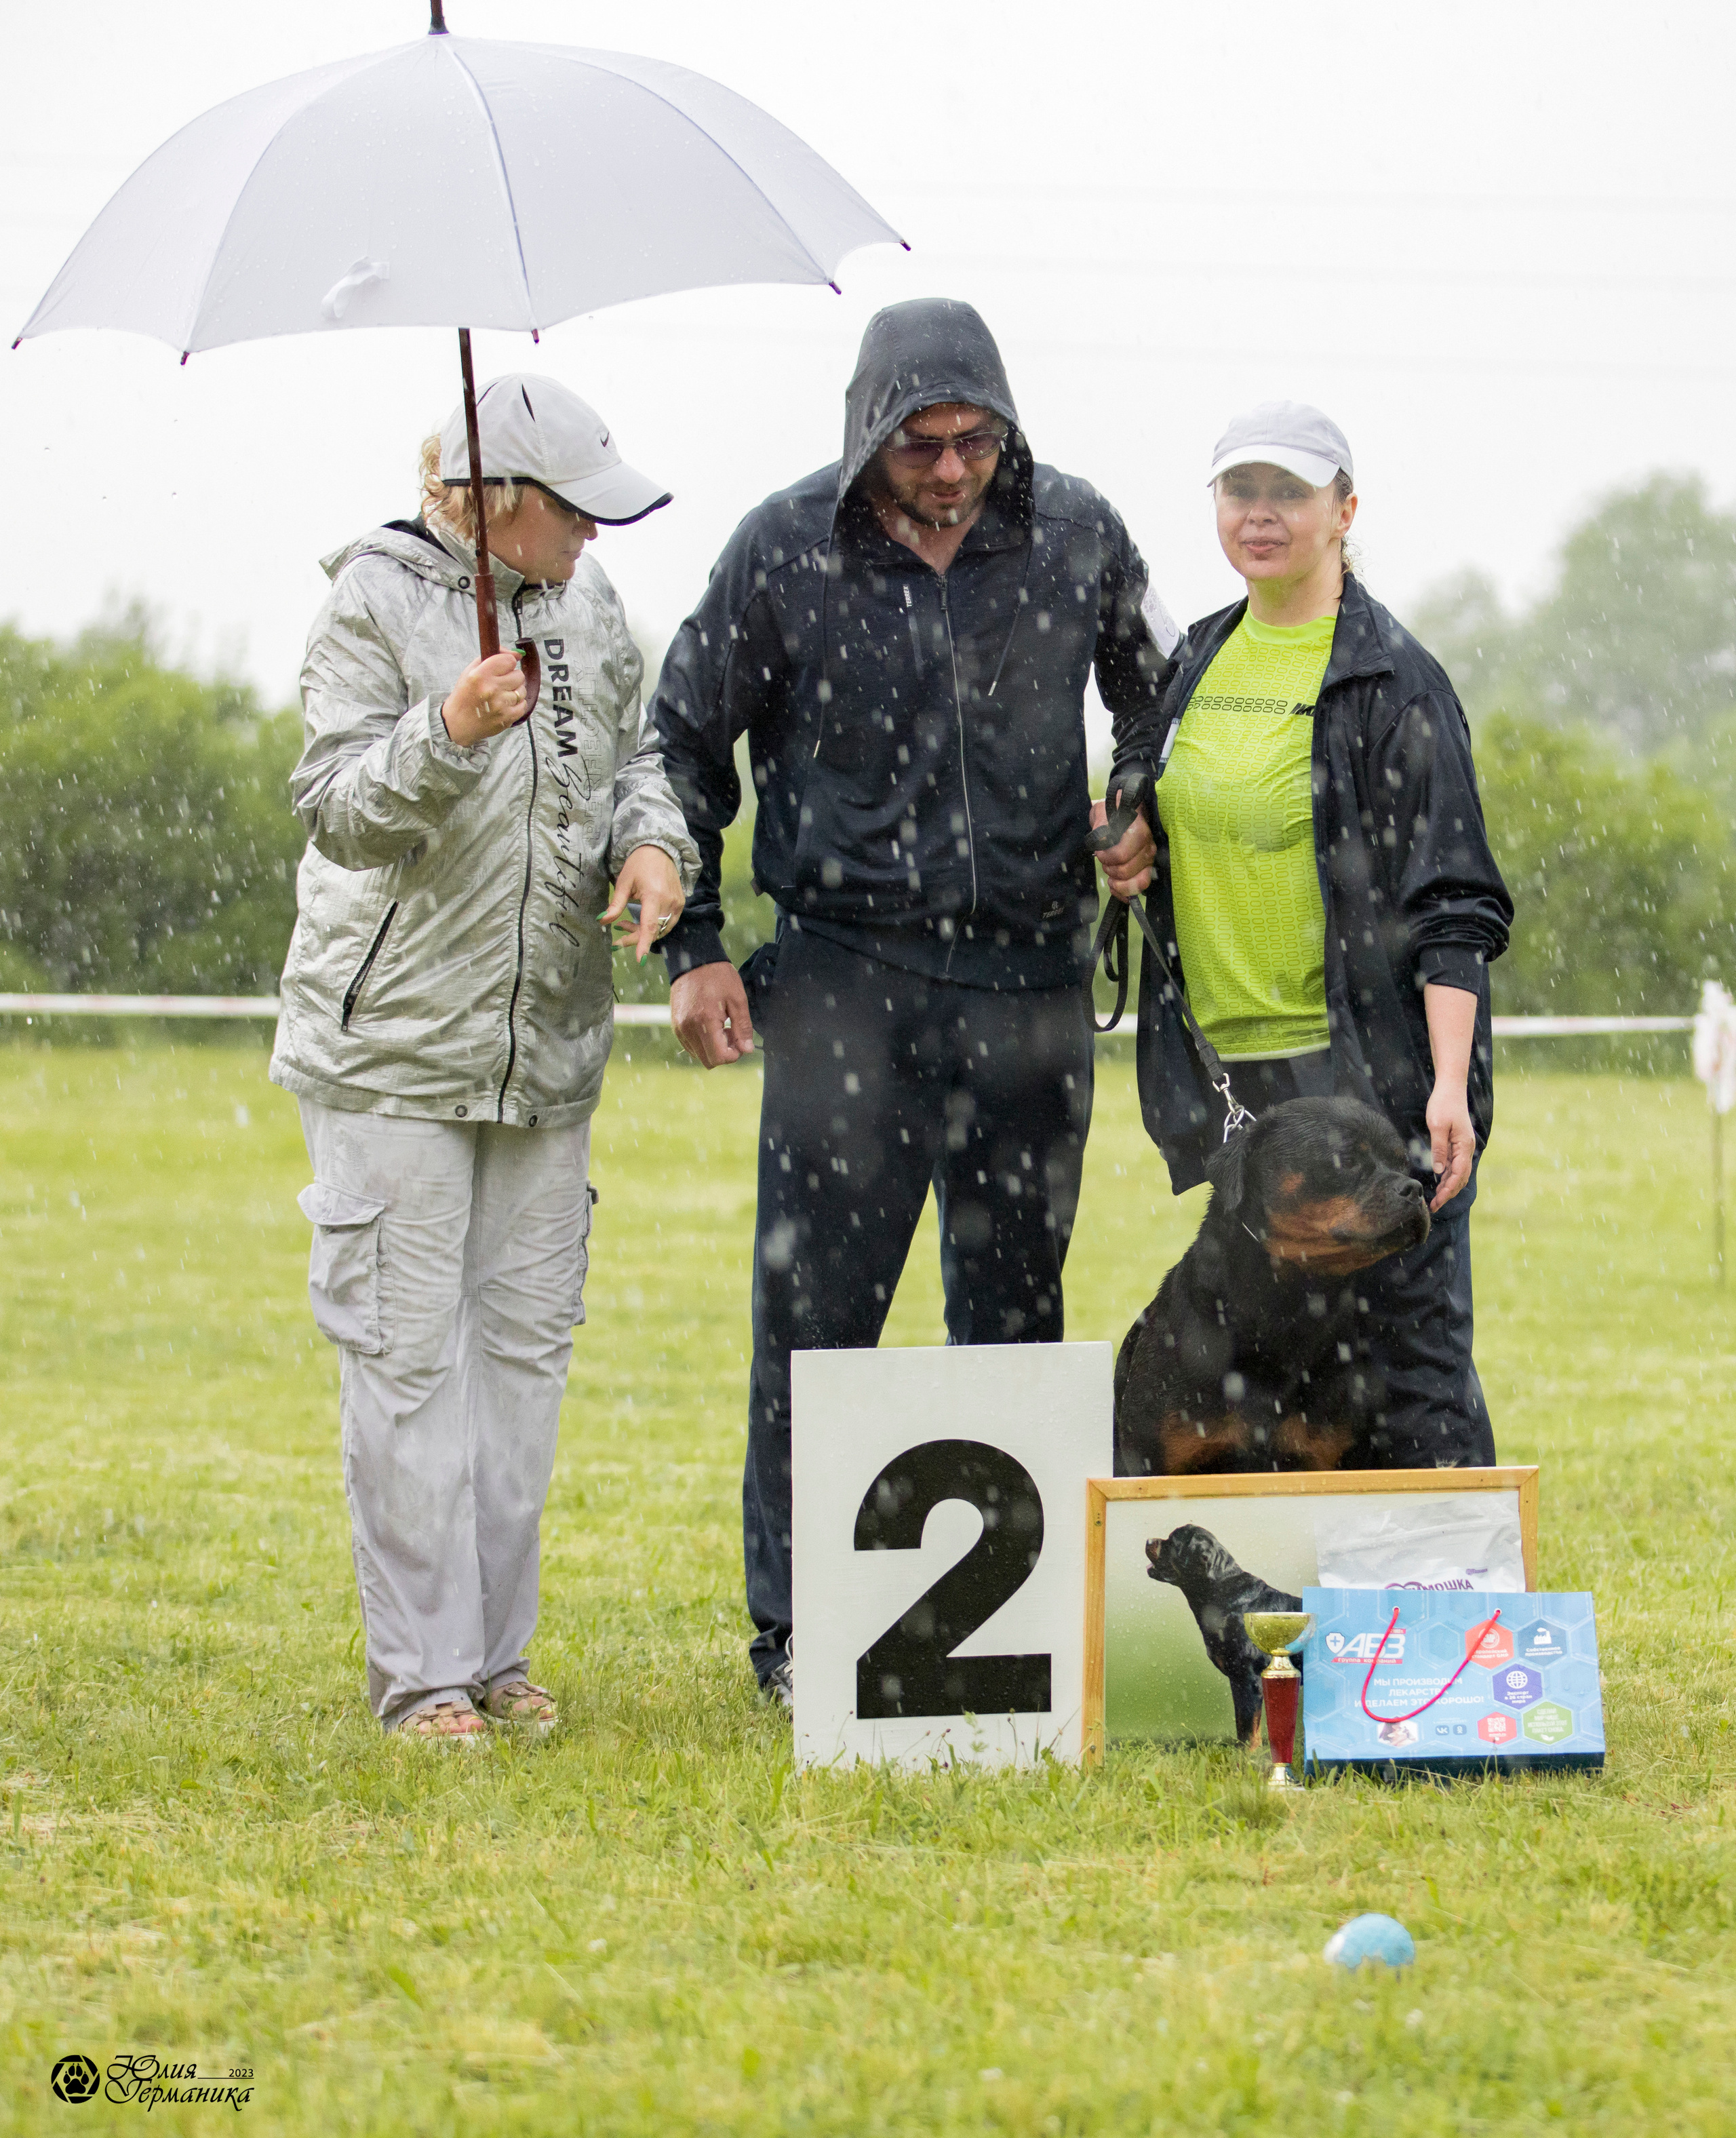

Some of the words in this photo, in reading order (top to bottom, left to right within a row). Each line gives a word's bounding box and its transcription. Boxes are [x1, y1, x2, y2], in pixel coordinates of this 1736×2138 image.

[903, 585, 912, 607] TERREX
[543, 638, 578, 758] DREAM
[545, 754, 591, 948] Beautiful
[854, 1439, 1052, 1719] 2
[1374, 1678, 1390, 1686] МЫ
[1388, 1688, 1448, 1696] ЛЕКАРСТВ
[1365, 1699, 1408, 1708] ДЕЛАЕМ
